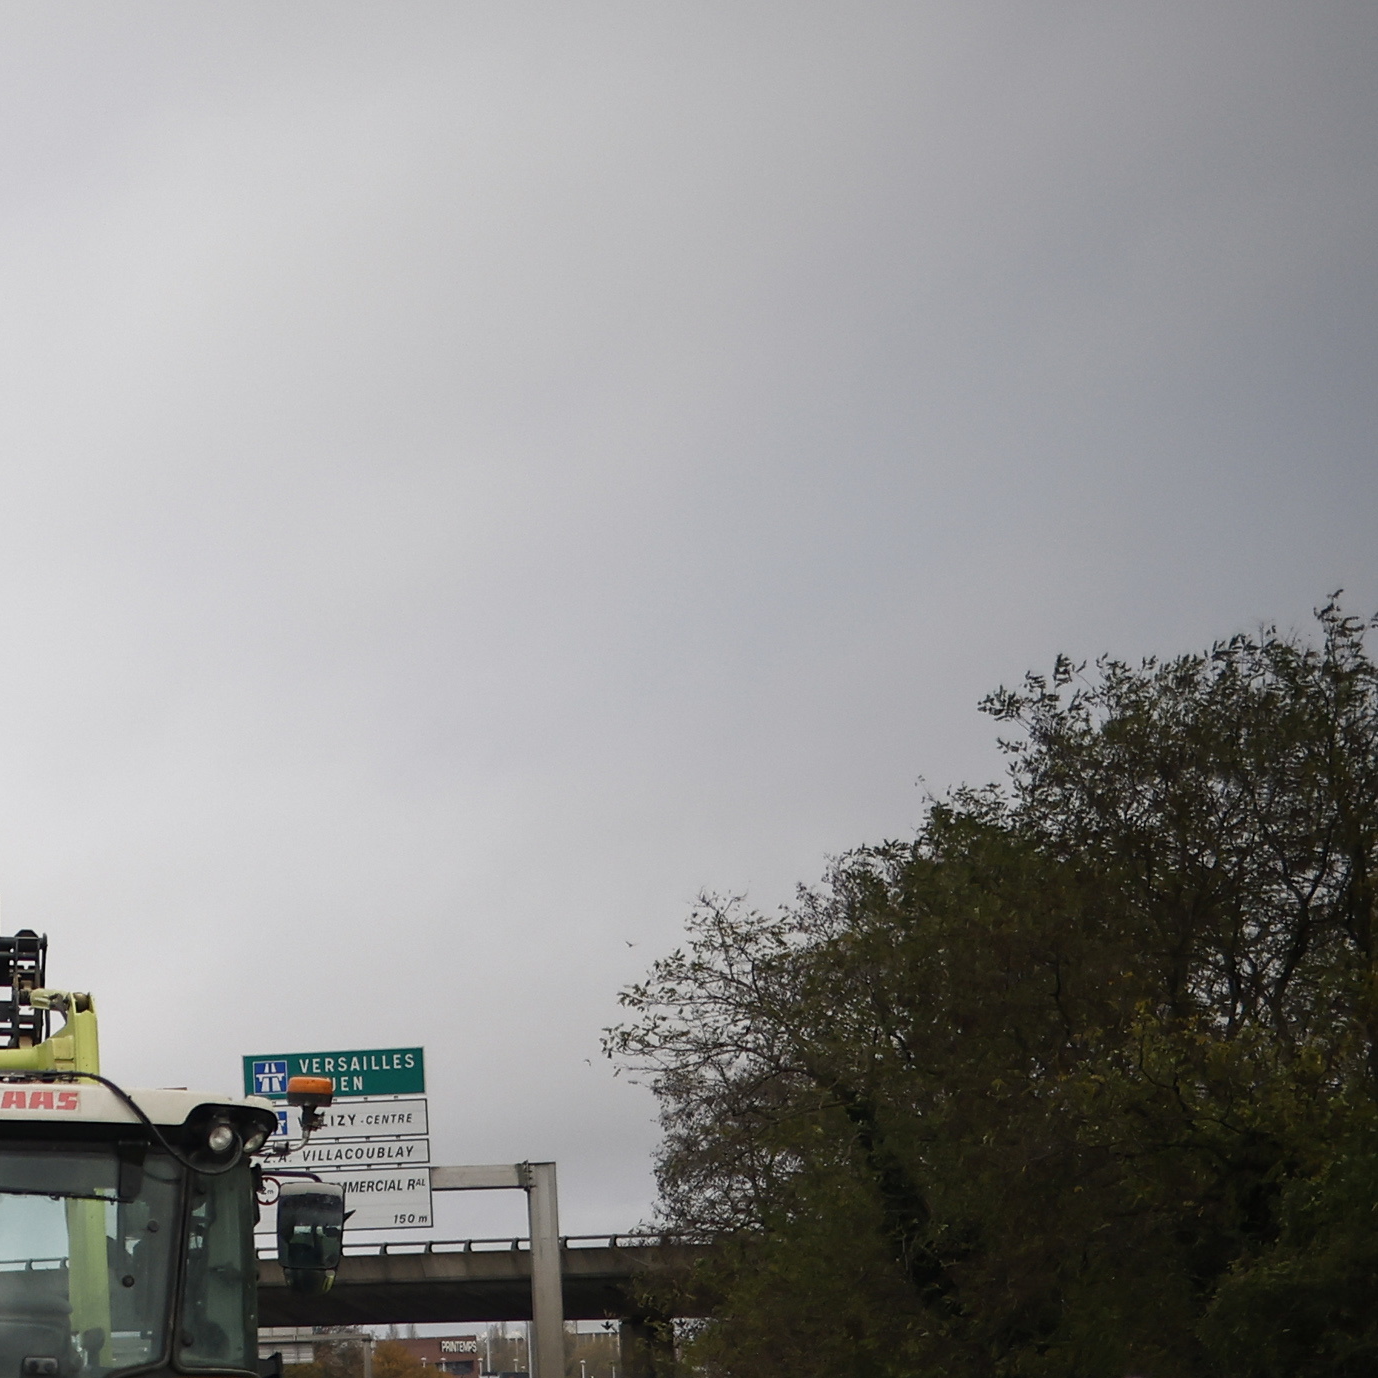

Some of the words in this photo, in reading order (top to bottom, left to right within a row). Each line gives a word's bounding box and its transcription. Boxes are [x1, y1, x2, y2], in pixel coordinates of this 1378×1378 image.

[299, 1053, 415, 1074] VERSAILLES
[302, 1145, 414, 1162] VILLACOUBLAY
[393, 1213, 415, 1224] 150
[417, 1215, 428, 1223] m
[441, 1340, 477, 1353] PRINTEMPS
